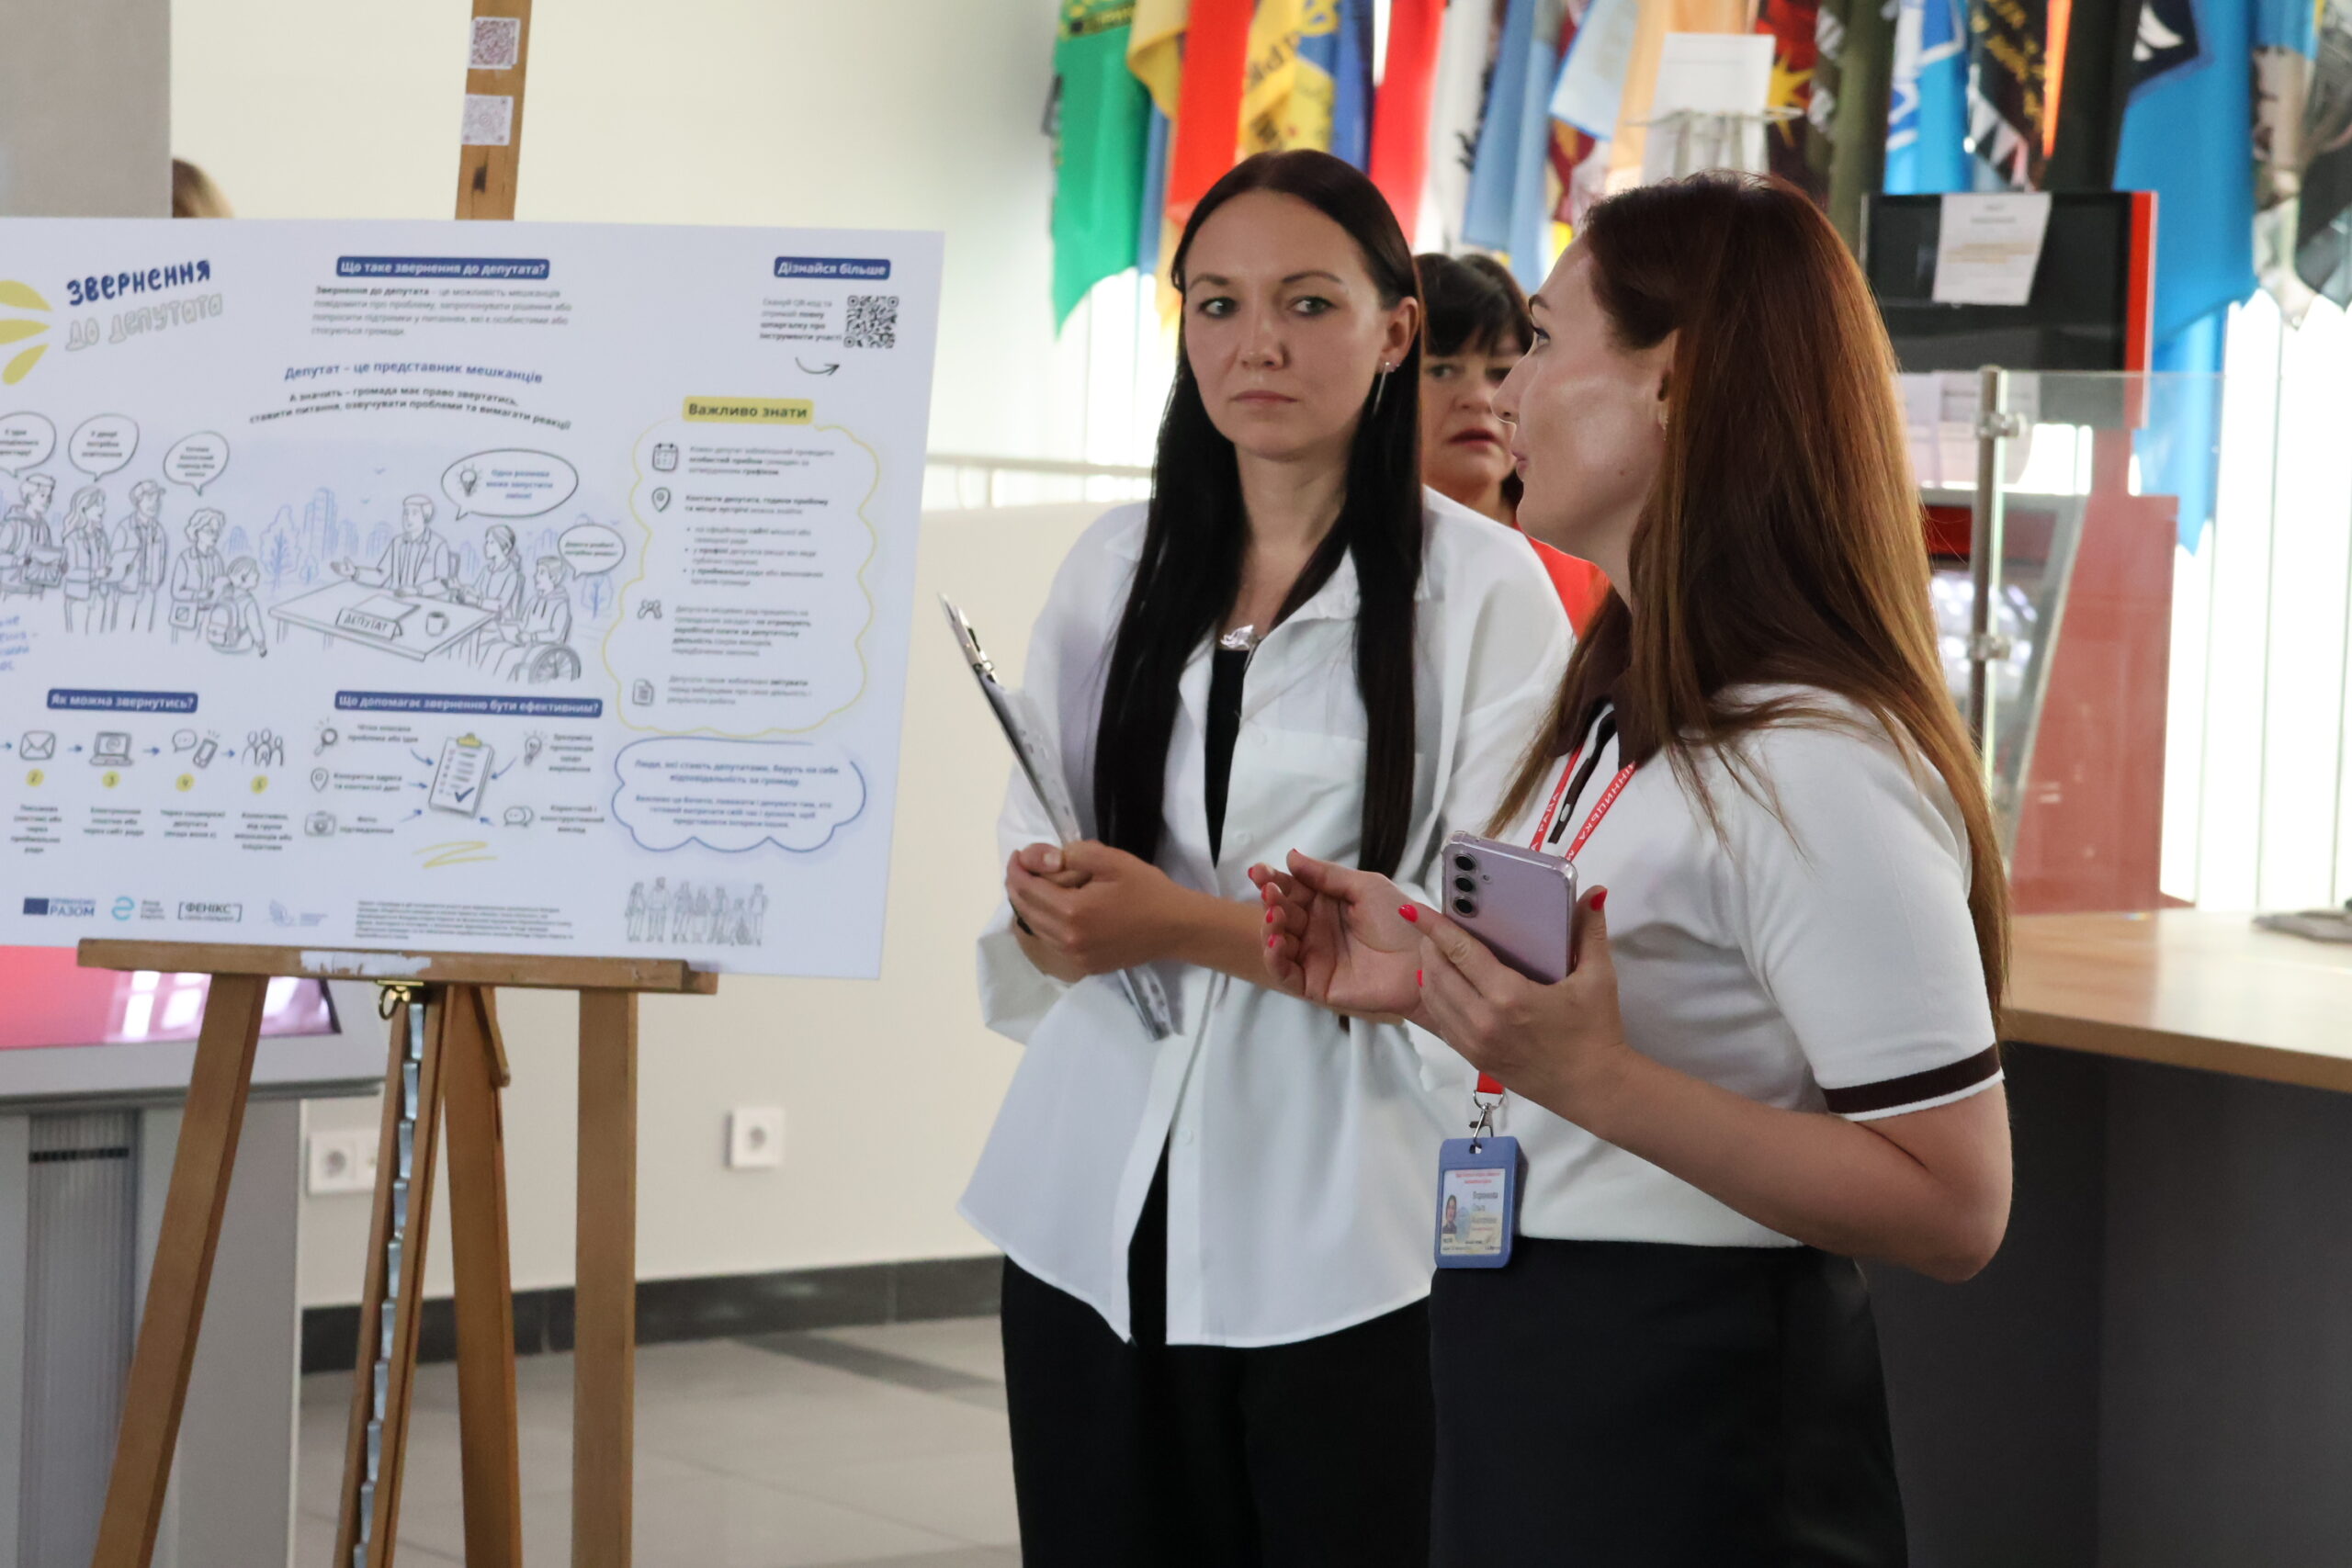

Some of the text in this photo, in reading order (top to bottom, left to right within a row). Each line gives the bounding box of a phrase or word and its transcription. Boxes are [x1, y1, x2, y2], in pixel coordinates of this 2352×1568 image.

[341, 262, 546, 277] Що таке звернення до депутата?
[778, 262, 886, 275] Дізнайся більше
[284, 364, 340, 380] Депутат
[354, 363, 370, 373] це
[373, 361, 463, 374] представник
[467, 365, 543, 384] мешканців
[423, 388, 455, 399] право
[689, 403, 807, 418] Важливо знати
[344, 615, 388, 631] ДЕПУТАТ
[51, 694, 194, 711] Як можна звернутись?
[339, 696, 357, 706] Що
[360, 697, 422, 709] допомагає
[491, 699, 516, 712] бути
[50, 905, 95, 917] РАЗОМ
[186, 903, 232, 914] ФЕНІКС
